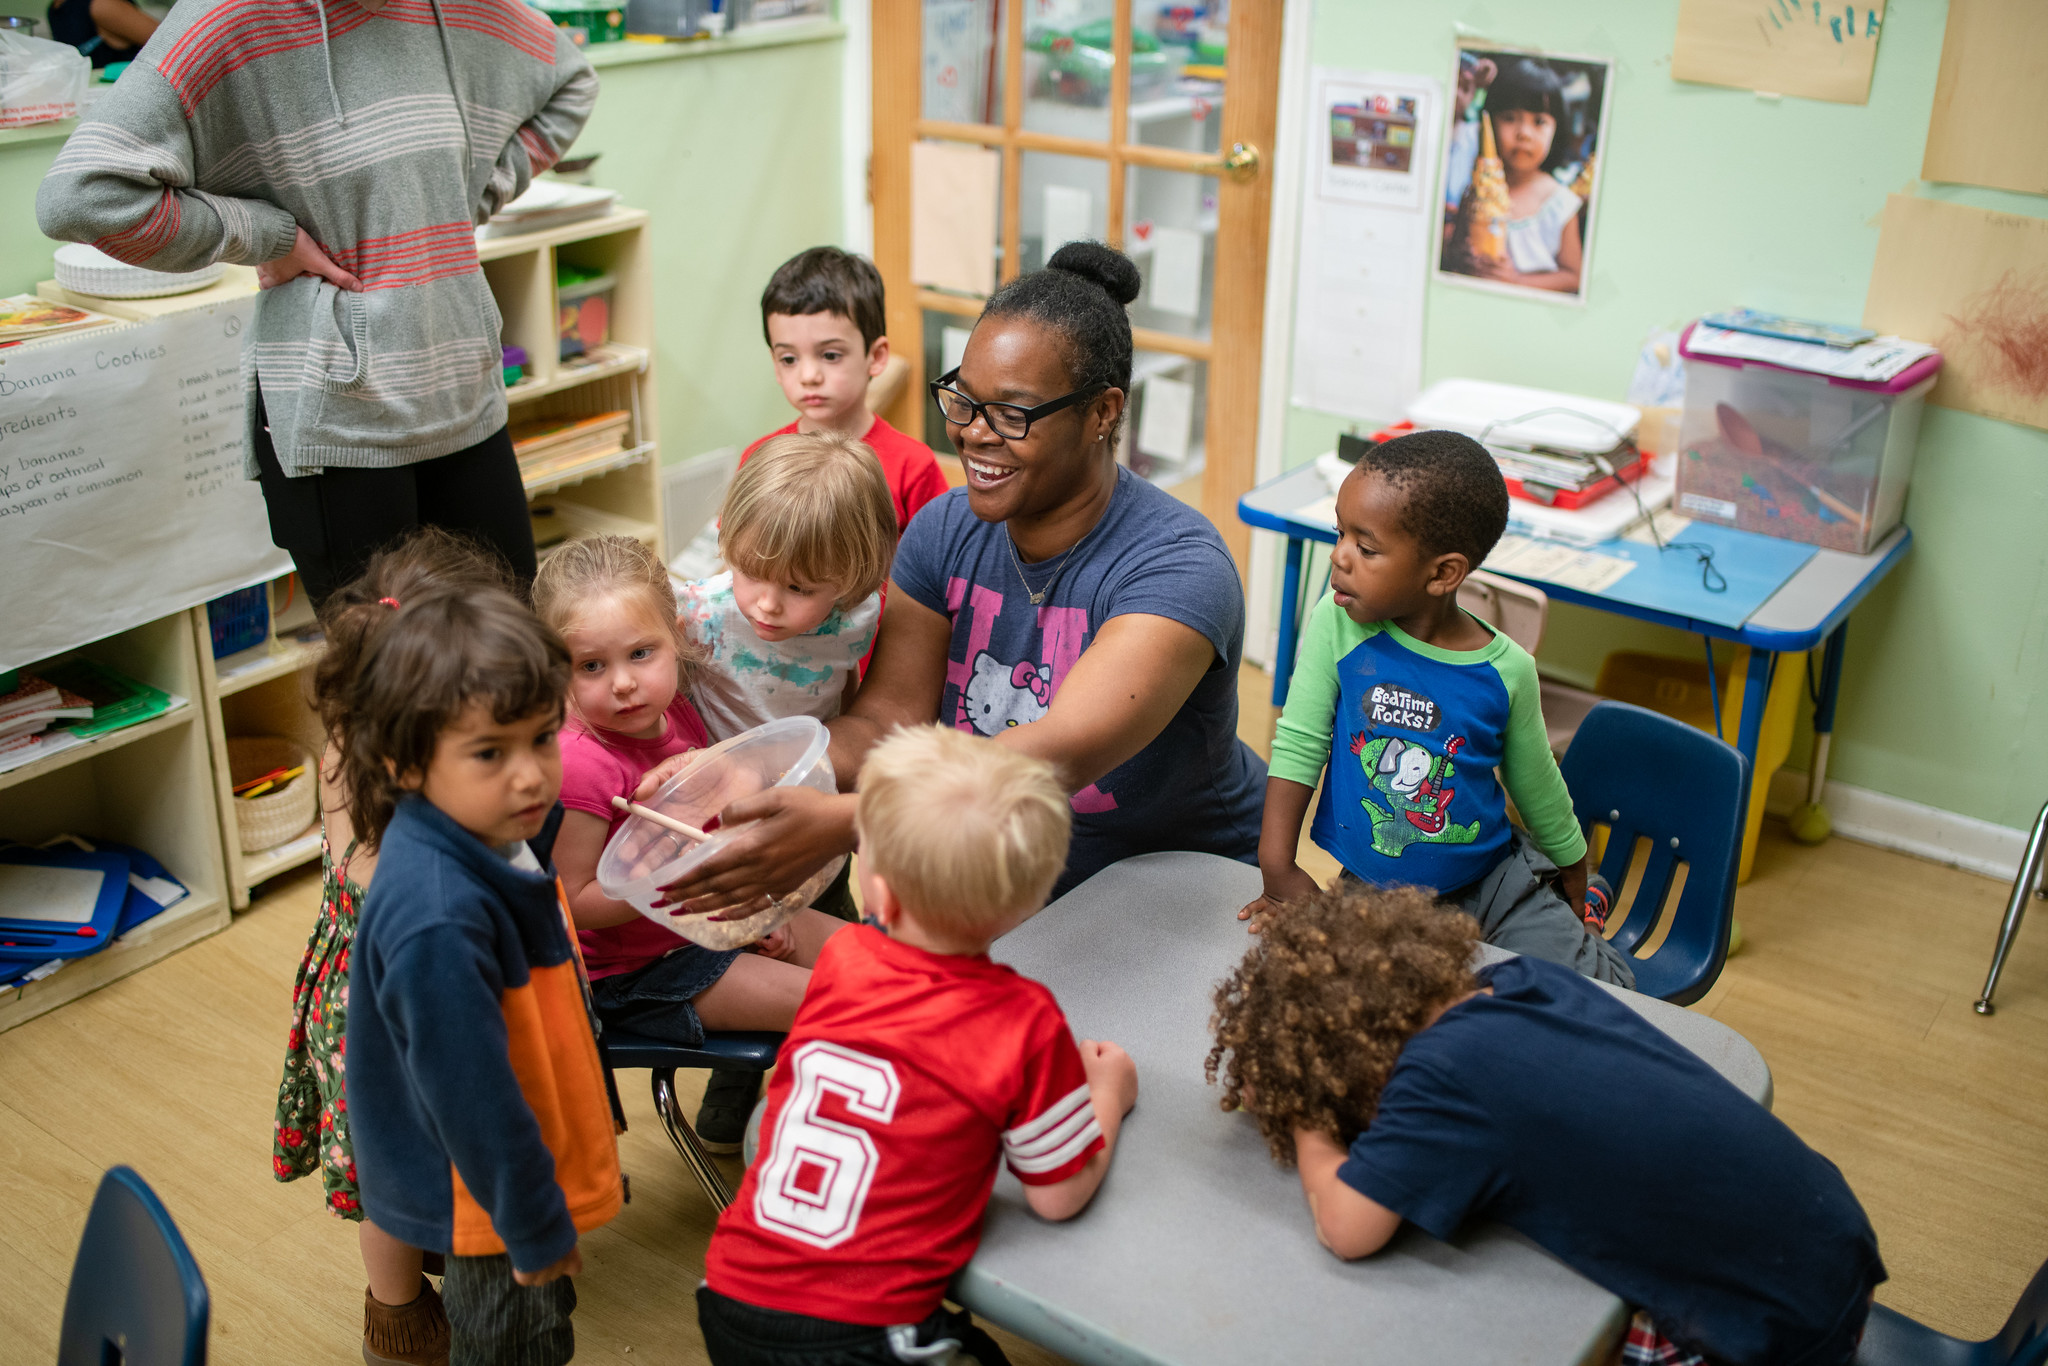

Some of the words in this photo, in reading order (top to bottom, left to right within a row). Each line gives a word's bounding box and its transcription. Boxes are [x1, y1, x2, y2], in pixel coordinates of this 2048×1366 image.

[0, 367, 76, 397] Banana
[95, 344, 167, 370] Cookies
[0, 465, 10, 480] y
[18, 446, 85, 471] bananas
[26, 472, 43, 490] of
[49, 458, 104, 483] oatmeal
[0, 497, 48, 517] aspoon
[54, 486, 70, 501] of
[77, 469, 143, 495] cinnamon
[754, 1040, 901, 1250] 6
